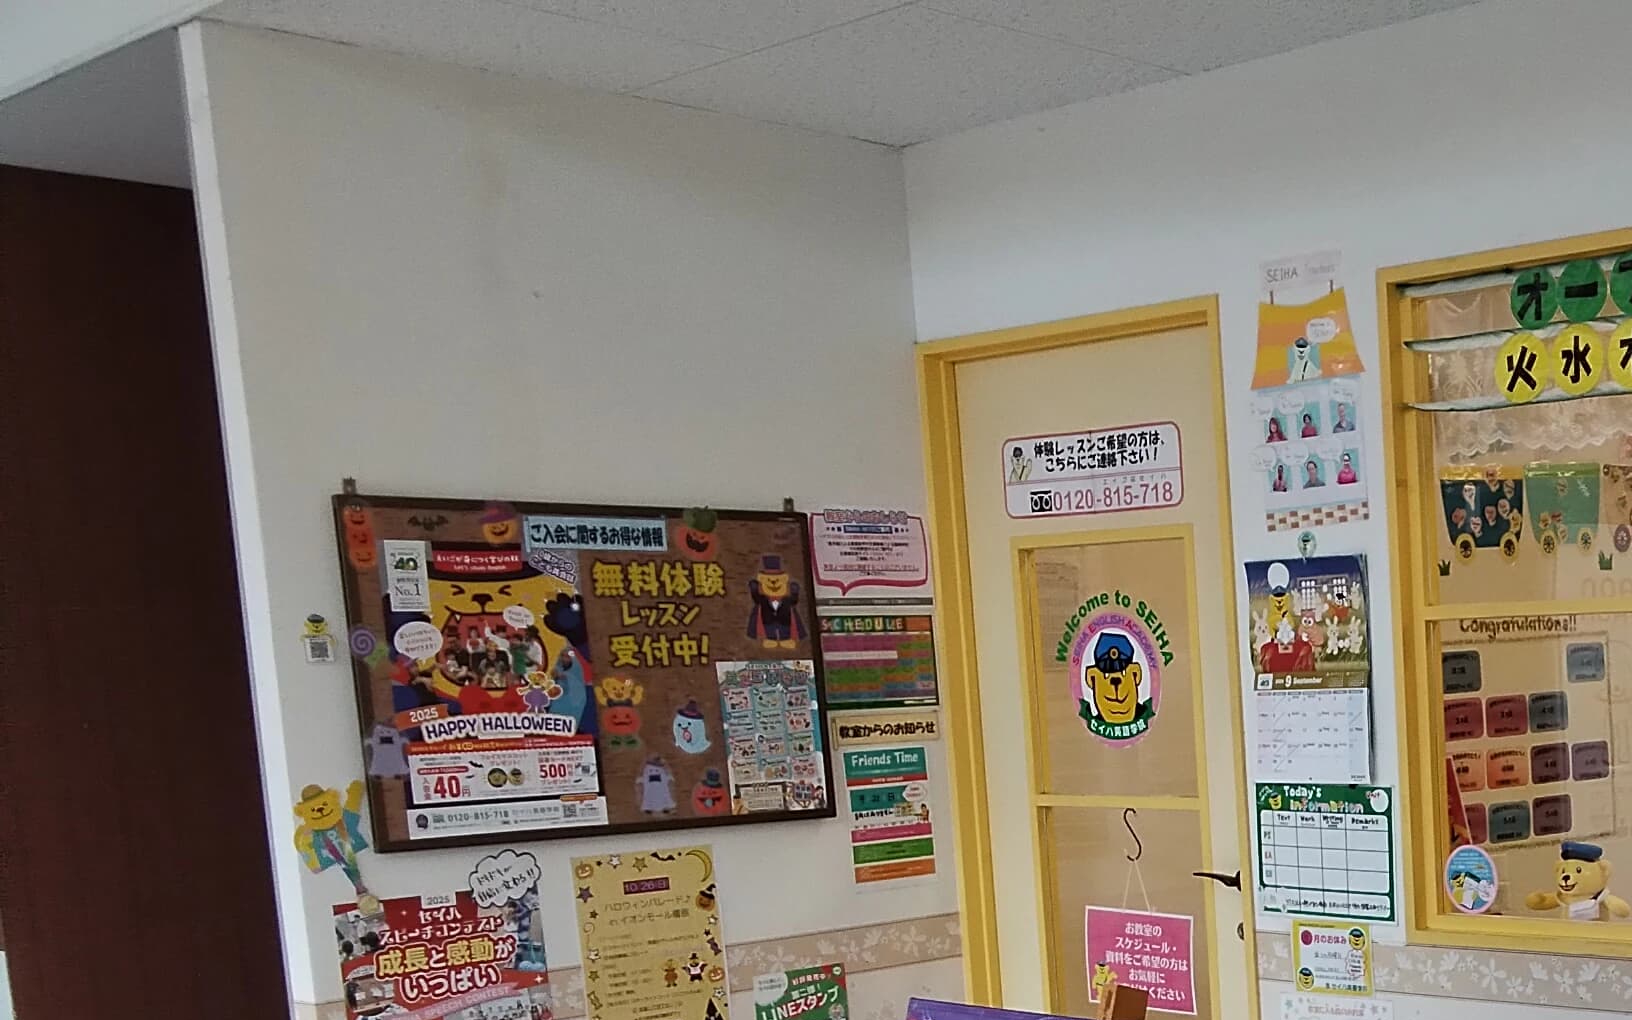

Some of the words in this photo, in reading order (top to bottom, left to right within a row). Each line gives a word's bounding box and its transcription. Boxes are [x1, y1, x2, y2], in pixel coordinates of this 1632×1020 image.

[1053, 481, 1173, 511] 0120-815-718
[591, 560, 726, 598] 無料体験
[621, 601, 700, 627] レッスン
[821, 617, 904, 631] SCHEDULE
[1087, 613, 1127, 634] ENGLISH
[1055, 592, 1109, 662] Welcome
[1114, 589, 1131, 609] to
[1135, 600, 1175, 667] SEIHA
[609, 633, 711, 668] 受付中!
[409, 707, 439, 723] 2025
[424, 718, 479, 741] HAPPY
[481, 715, 574, 734] HALLOWEEN
[539, 763, 568, 779] 500
[851, 753, 891, 768] Friends
[894, 751, 919, 763] Time
[433, 775, 461, 799] 40
[418, 906, 462, 924] セイハ
[1124, 922, 1162, 937] お教室の
[377, 936, 514, 977] 成長と感動が
[1104, 949, 1189, 972] 資料をご希望の方は
[402, 964, 498, 999] いっぱい
[1128, 968, 1166, 984] お気軽に
